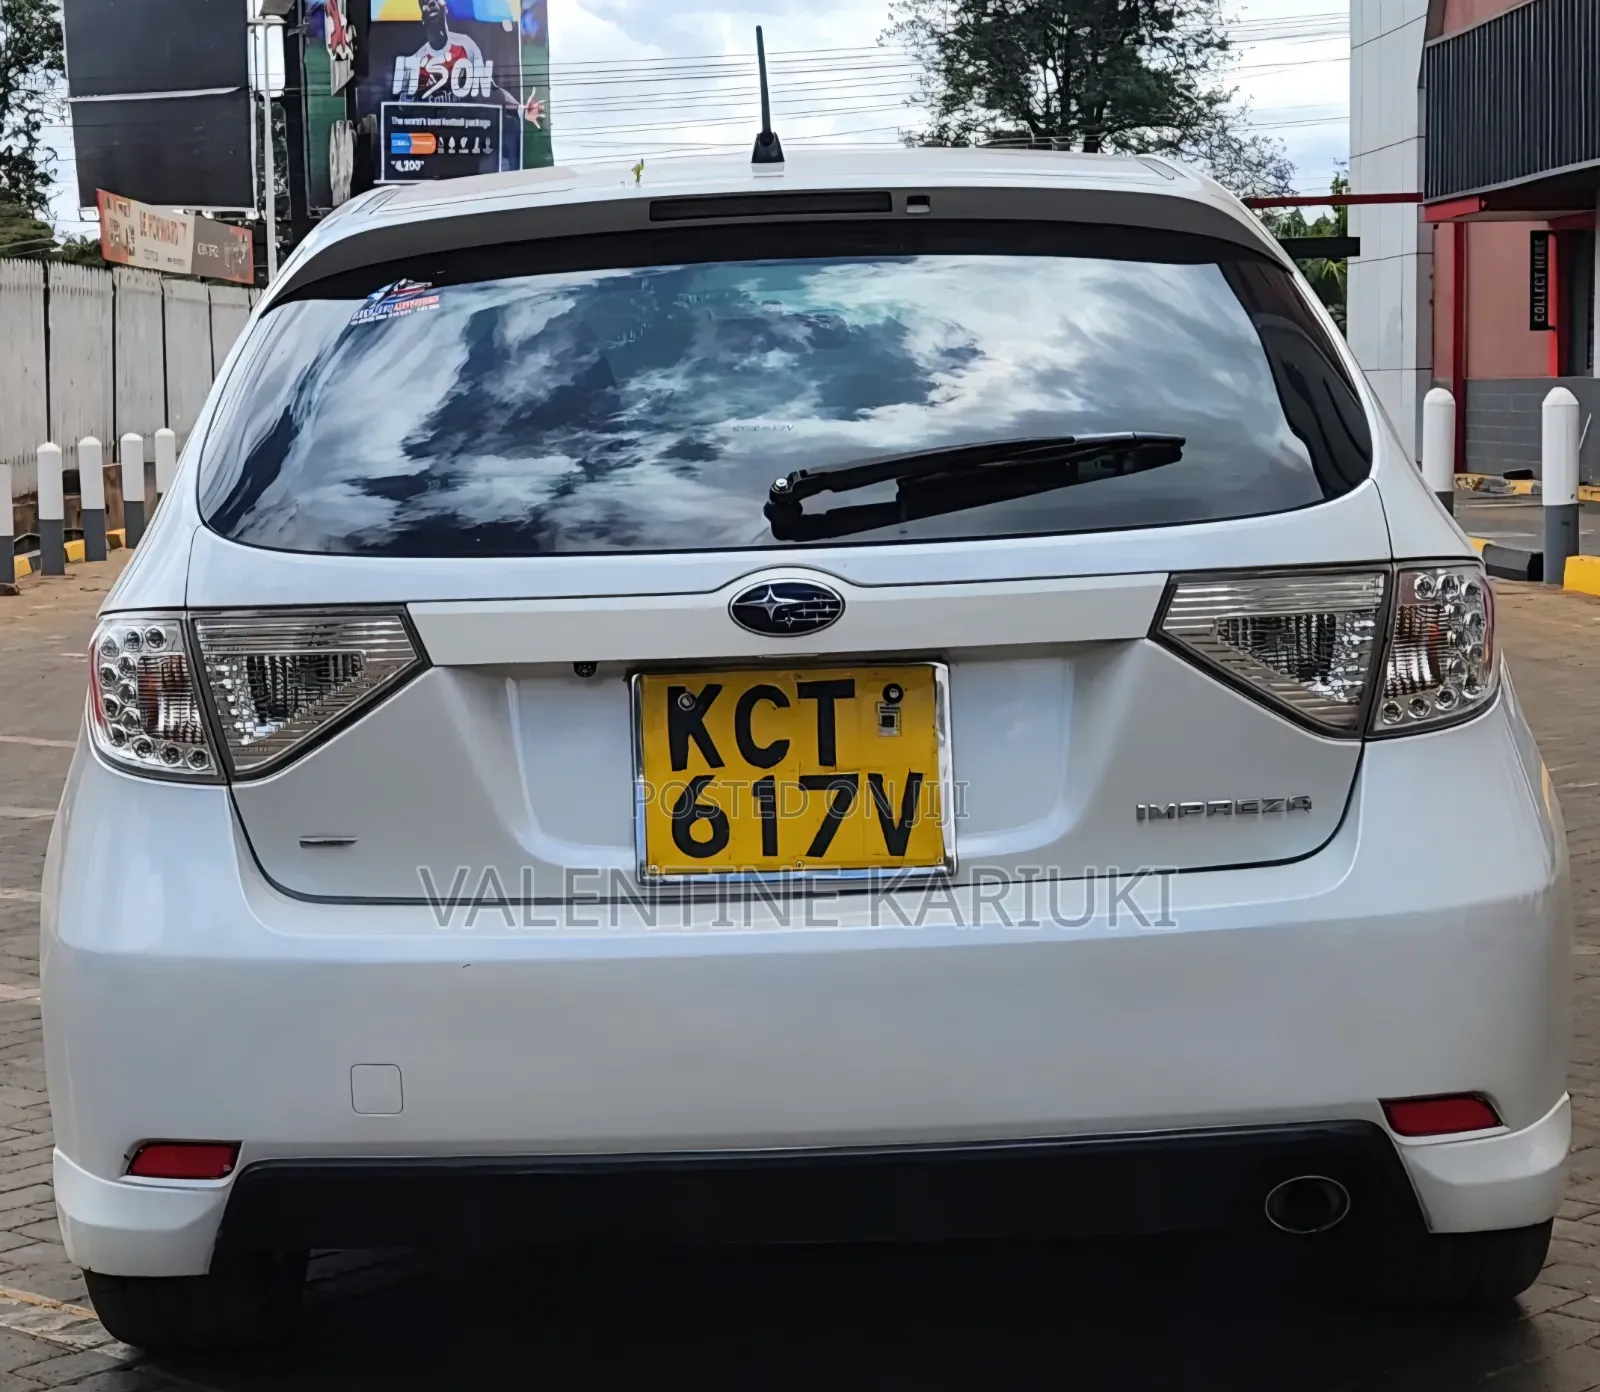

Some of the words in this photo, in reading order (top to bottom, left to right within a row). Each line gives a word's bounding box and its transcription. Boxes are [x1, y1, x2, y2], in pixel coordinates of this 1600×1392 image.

[1534, 272, 1546, 322] COLLECT
[667, 678, 855, 772] KCT
[671, 768, 924, 859] 617V
[1136, 795, 1313, 821] IMPREZA
